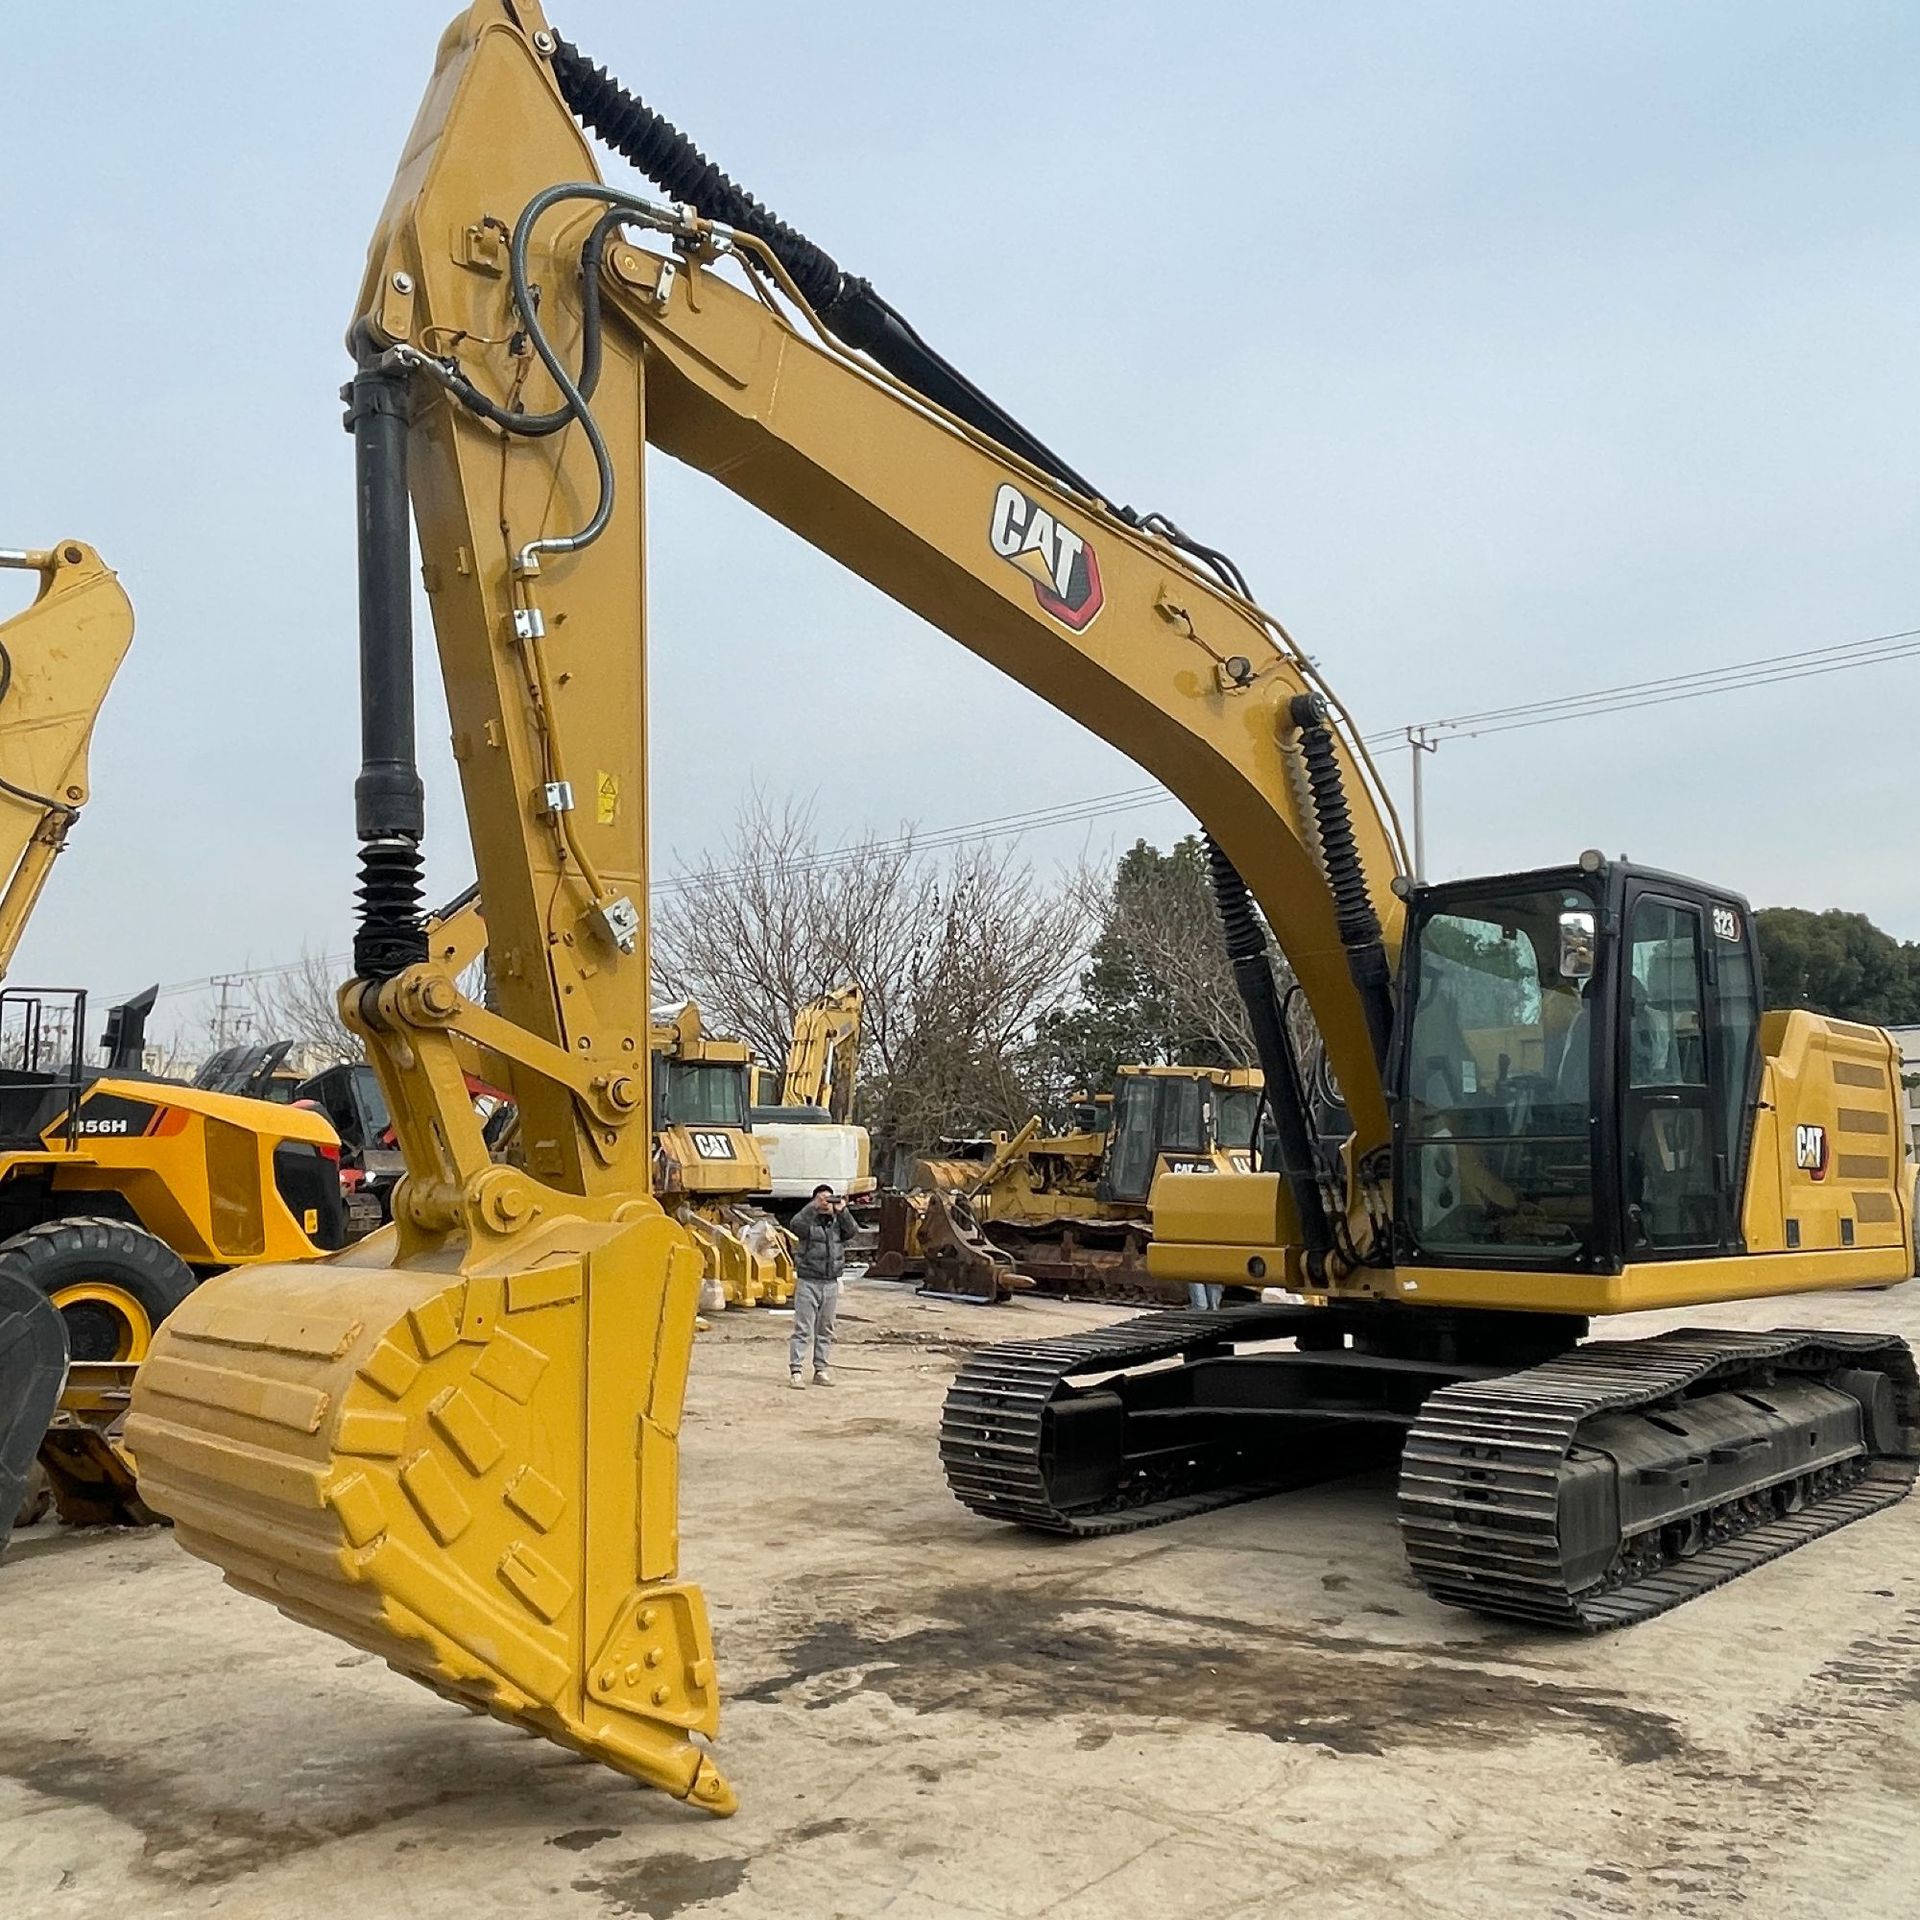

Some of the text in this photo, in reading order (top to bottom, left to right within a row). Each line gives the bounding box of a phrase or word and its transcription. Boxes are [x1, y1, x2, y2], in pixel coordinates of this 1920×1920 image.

[991, 484, 1084, 600] CAT
[1713, 908, 1735, 937] 323
[695, 1134, 732, 1158] CAT
[1797, 1126, 1823, 1168] CAT
[1174, 1163, 1195, 1174] CAT
